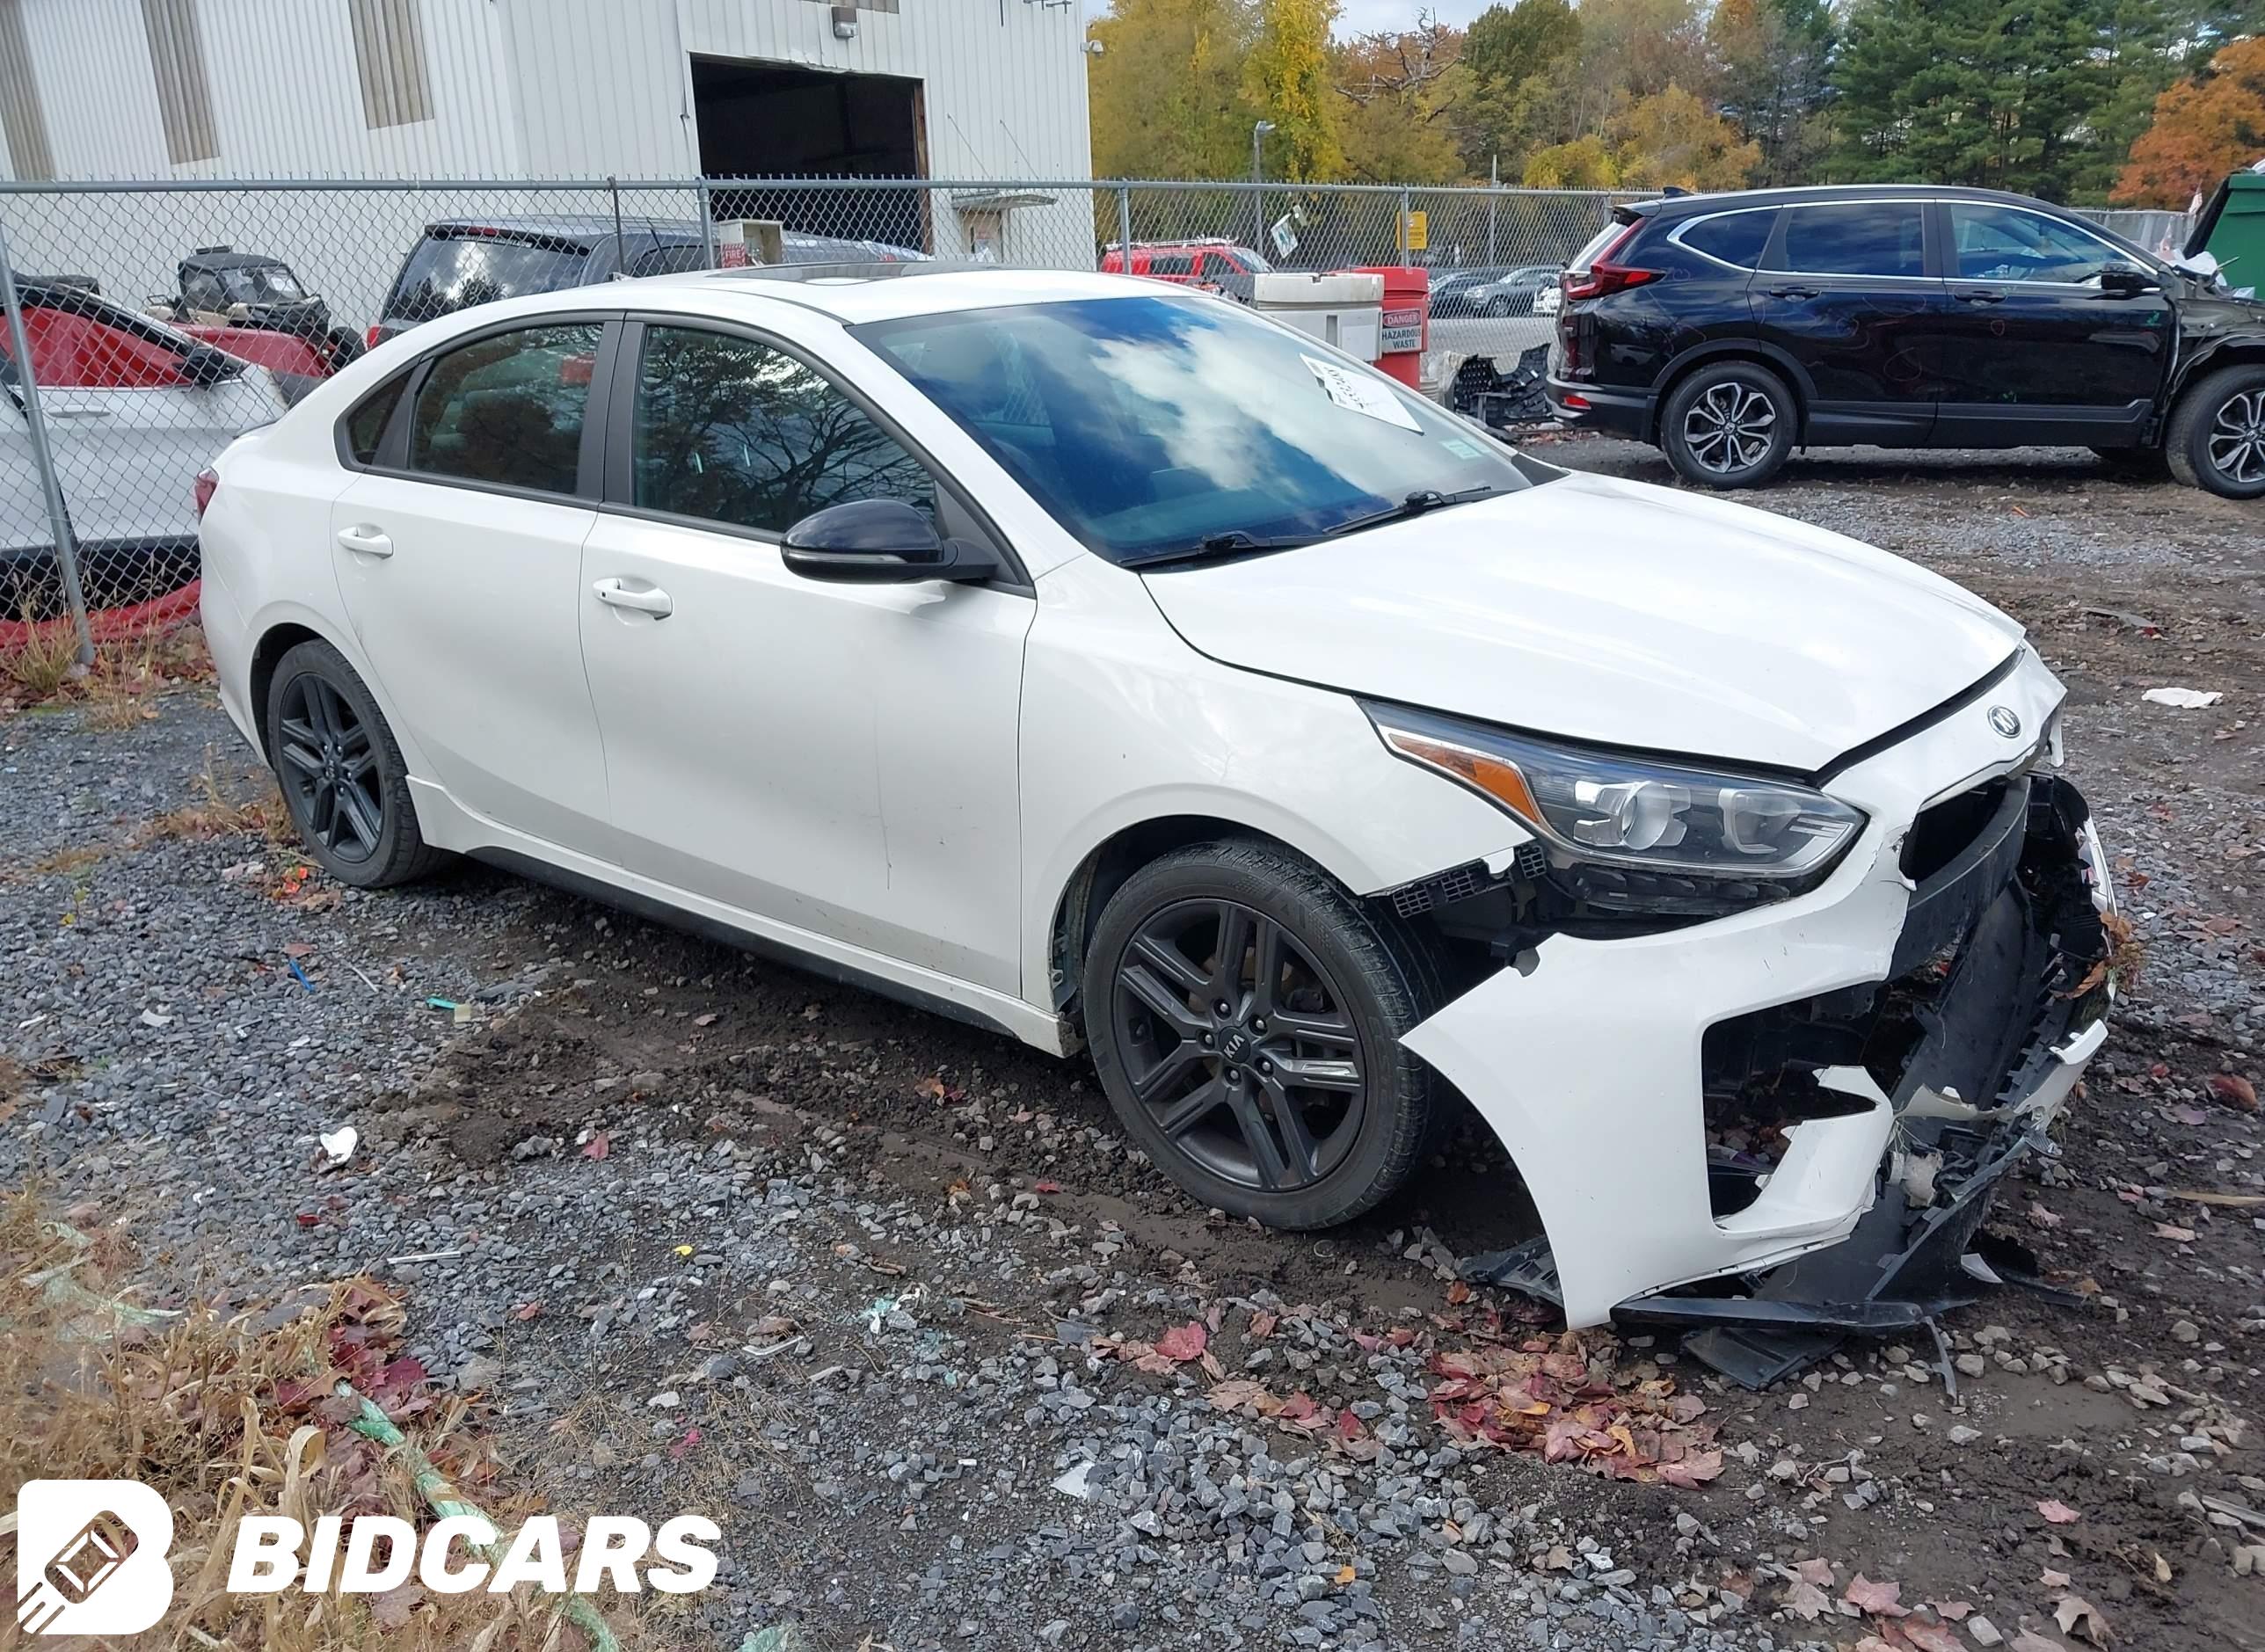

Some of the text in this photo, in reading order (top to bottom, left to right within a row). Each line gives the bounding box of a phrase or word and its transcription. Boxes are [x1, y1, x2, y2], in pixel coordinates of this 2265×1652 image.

[725, 250, 742, 259] FIRE
[1387, 314, 1418, 324] DANGER
[1382, 328, 1421, 341] HAZARDOUS
[1393, 339, 1416, 349] WASTE
[1223, 1034, 1245, 1059] KIA
